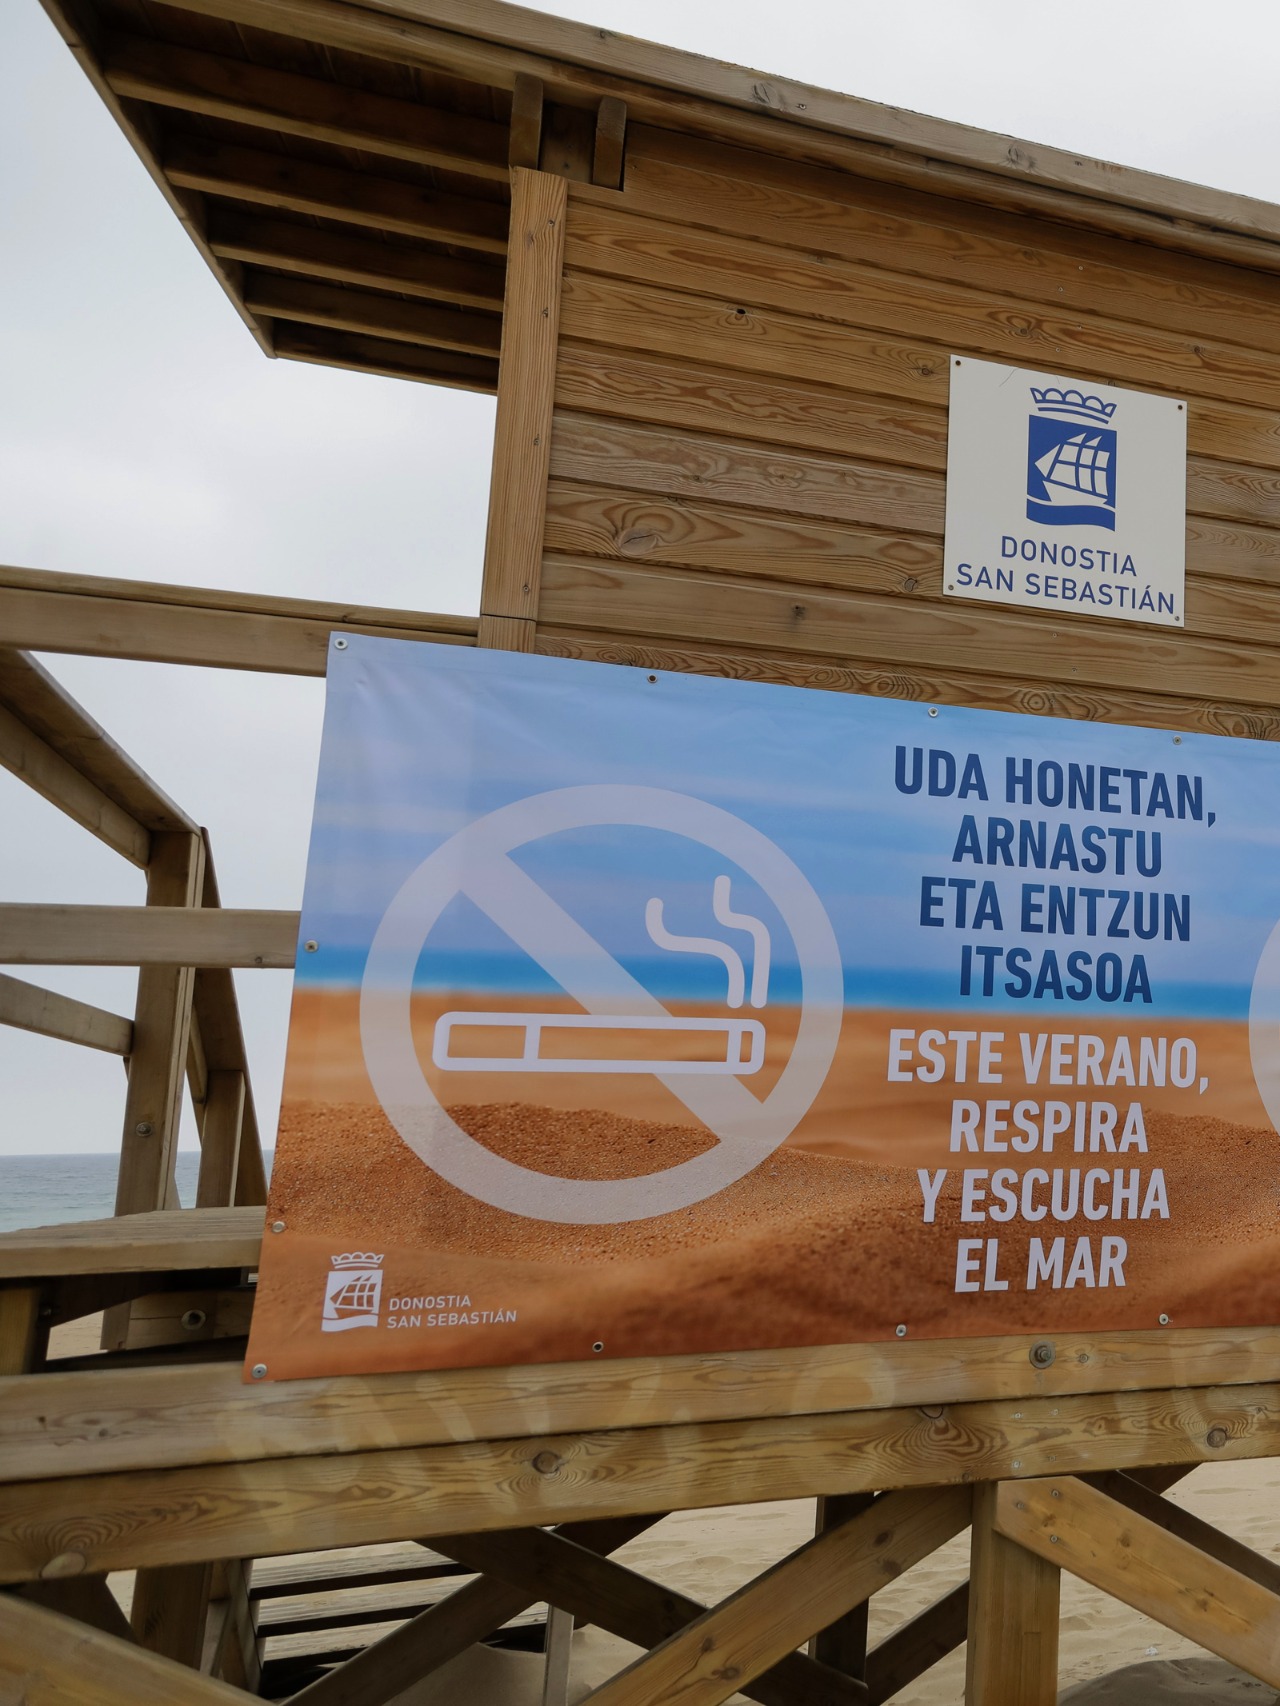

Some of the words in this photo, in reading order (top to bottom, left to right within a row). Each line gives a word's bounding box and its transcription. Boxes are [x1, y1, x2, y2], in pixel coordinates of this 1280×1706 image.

[1001, 535, 1137, 577] DONOSTIA
[956, 563, 1014, 593] SAN
[1025, 573, 1175, 615] SEBASTIÁN
[894, 745, 989, 801] UDA
[1005, 756, 1216, 828] HONETAN,
[952, 814, 1162, 878] ARNASTU
[919, 876, 1004, 931] ETA
[1020, 883, 1191, 942] ENTZUN
[959, 945, 1153, 1004] ITSASOA
[887, 1028, 1005, 1083] ESTE
[1019, 1032, 1209, 1095] VERANO,
[949, 1099, 1149, 1154] RESPIRA
[916, 1168, 948, 1223] Y
[960, 1168, 1171, 1223] ESCUCHA
[954, 1238, 1009, 1293] EL
[1026, 1236, 1129, 1290] MAR
[387, 1314, 421, 1329] SAN
[426, 1308, 518, 1327] SEBASTIÁN
[389, 1294, 471, 1311] DONOSTIA
